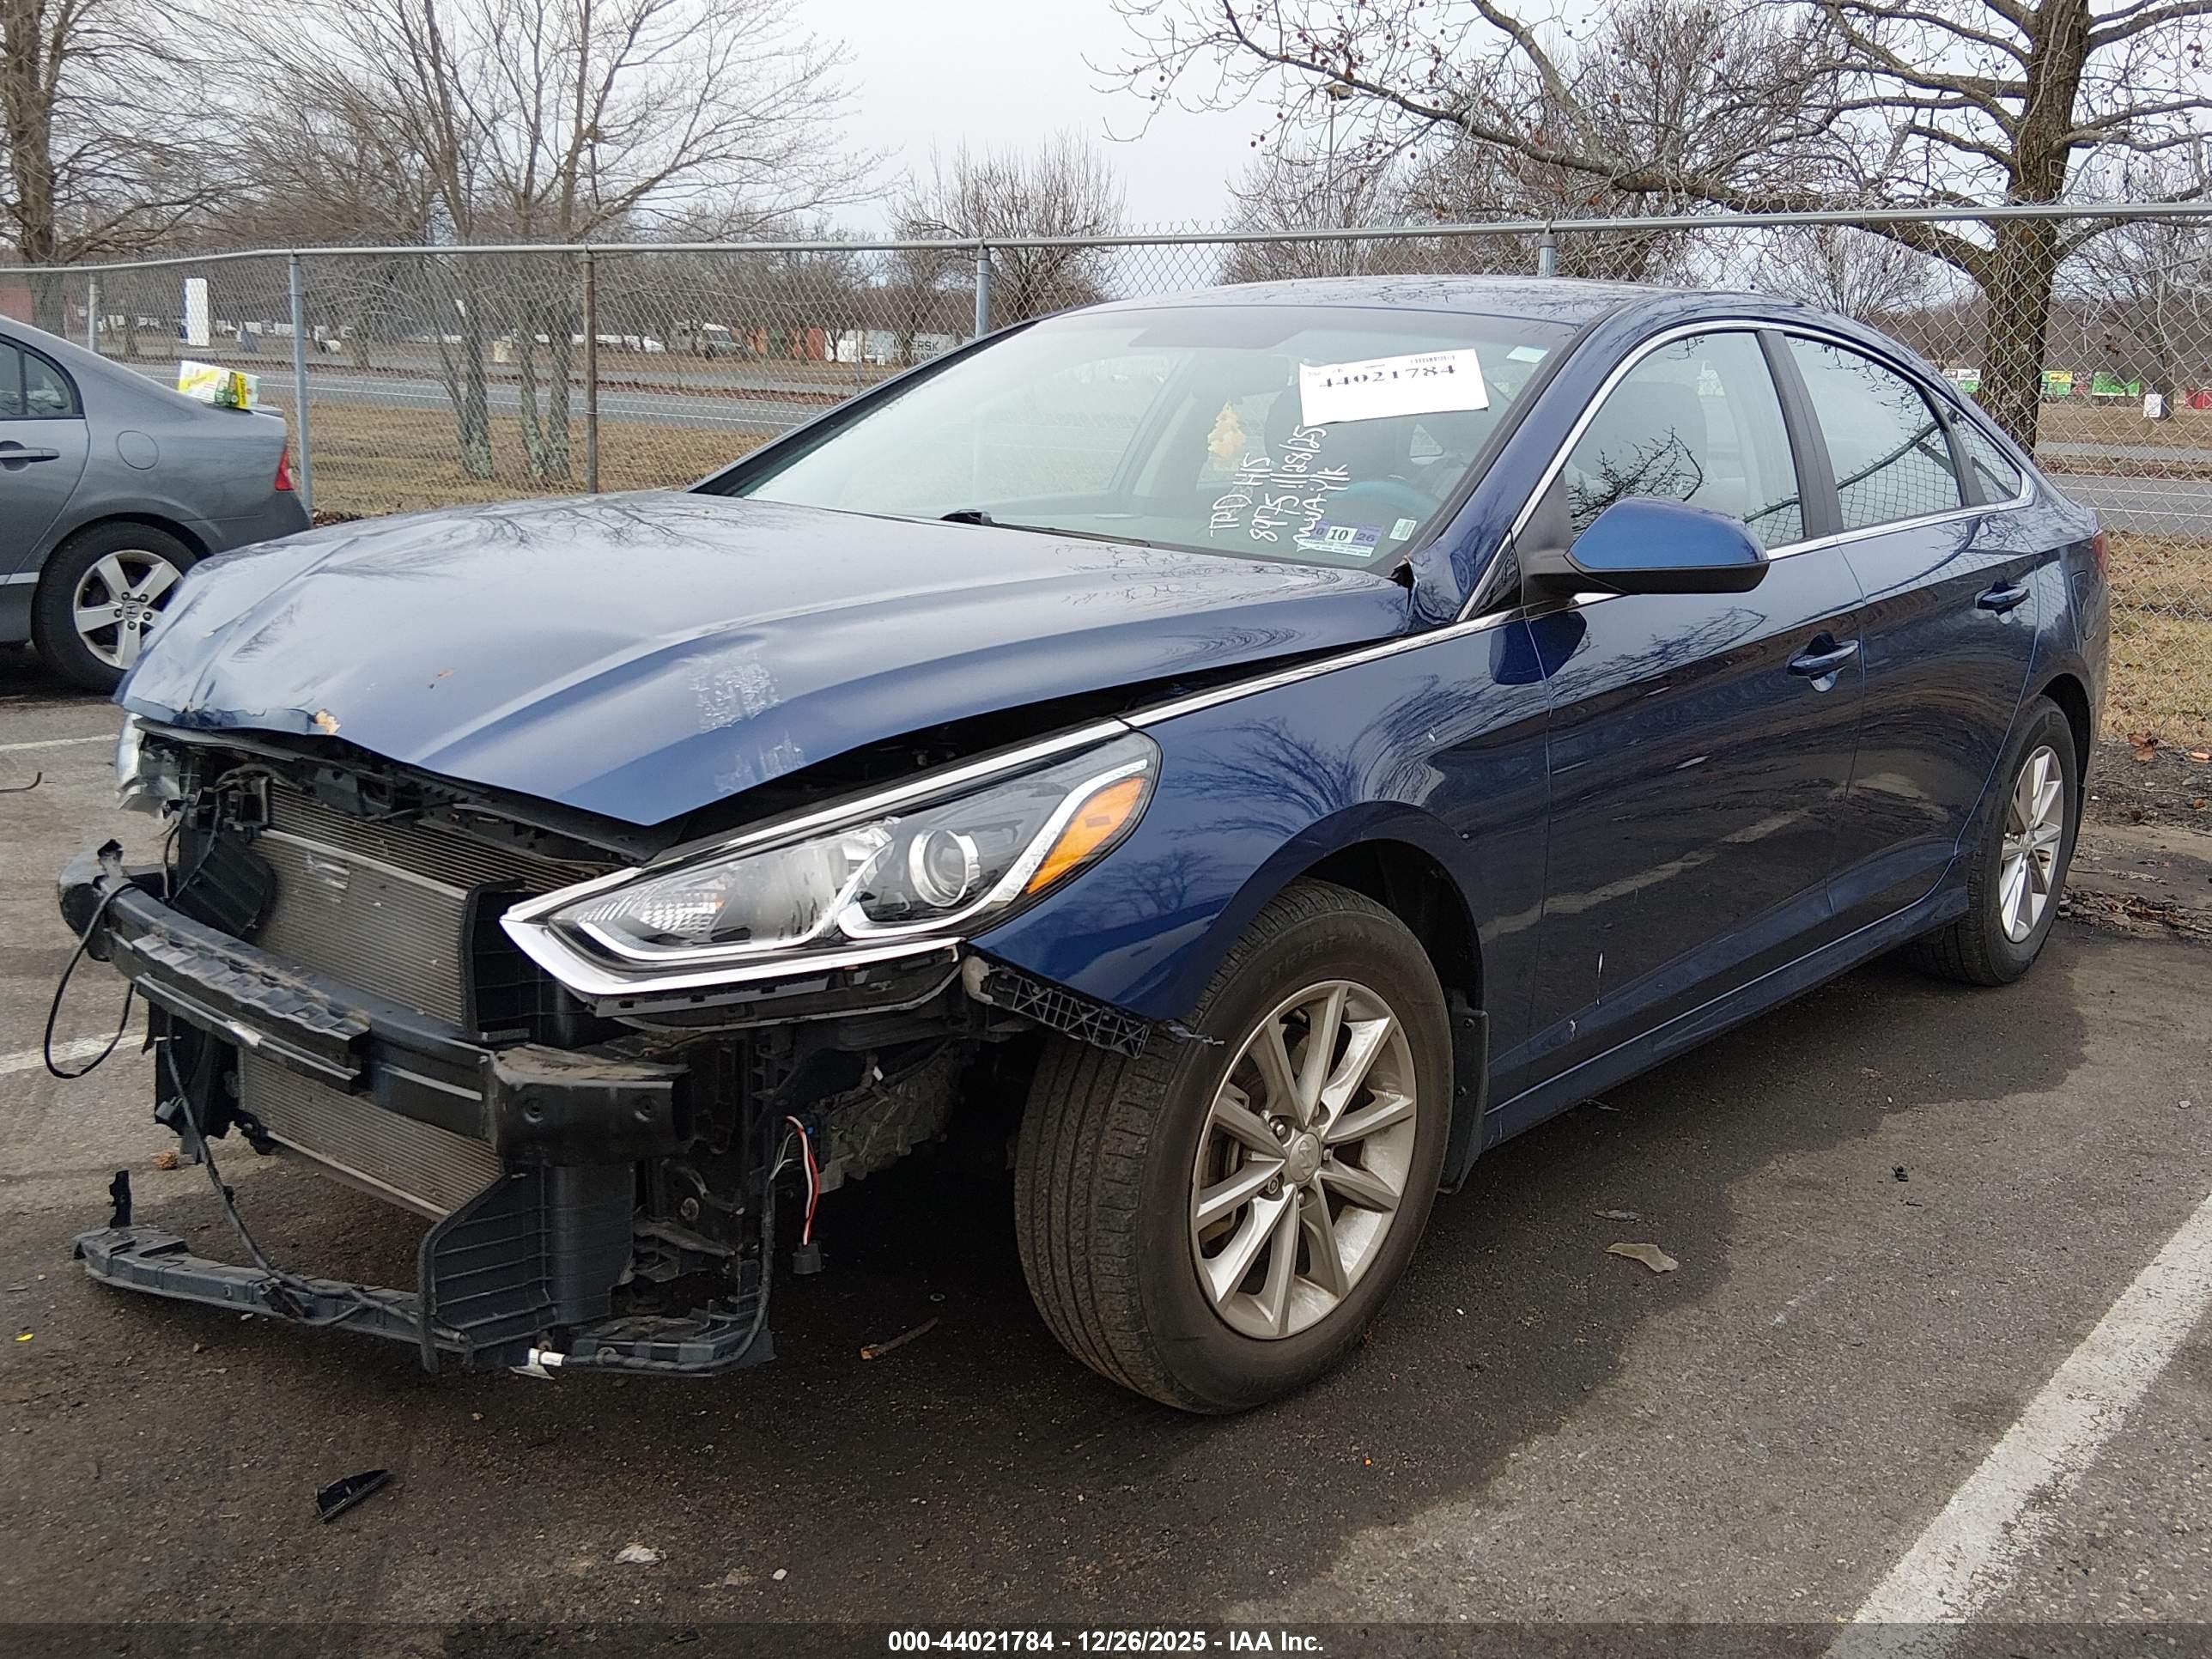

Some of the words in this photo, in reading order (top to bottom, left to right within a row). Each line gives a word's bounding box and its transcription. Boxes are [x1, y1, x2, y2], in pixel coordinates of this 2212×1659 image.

[1319, 365, 1455, 387] 44021784
[1269, 424, 1327, 489] 11/28/25
[1208, 494, 1252, 538] TPD
[1249, 493, 1301, 542] 8975
[1328, 528, 1349, 541] 10
